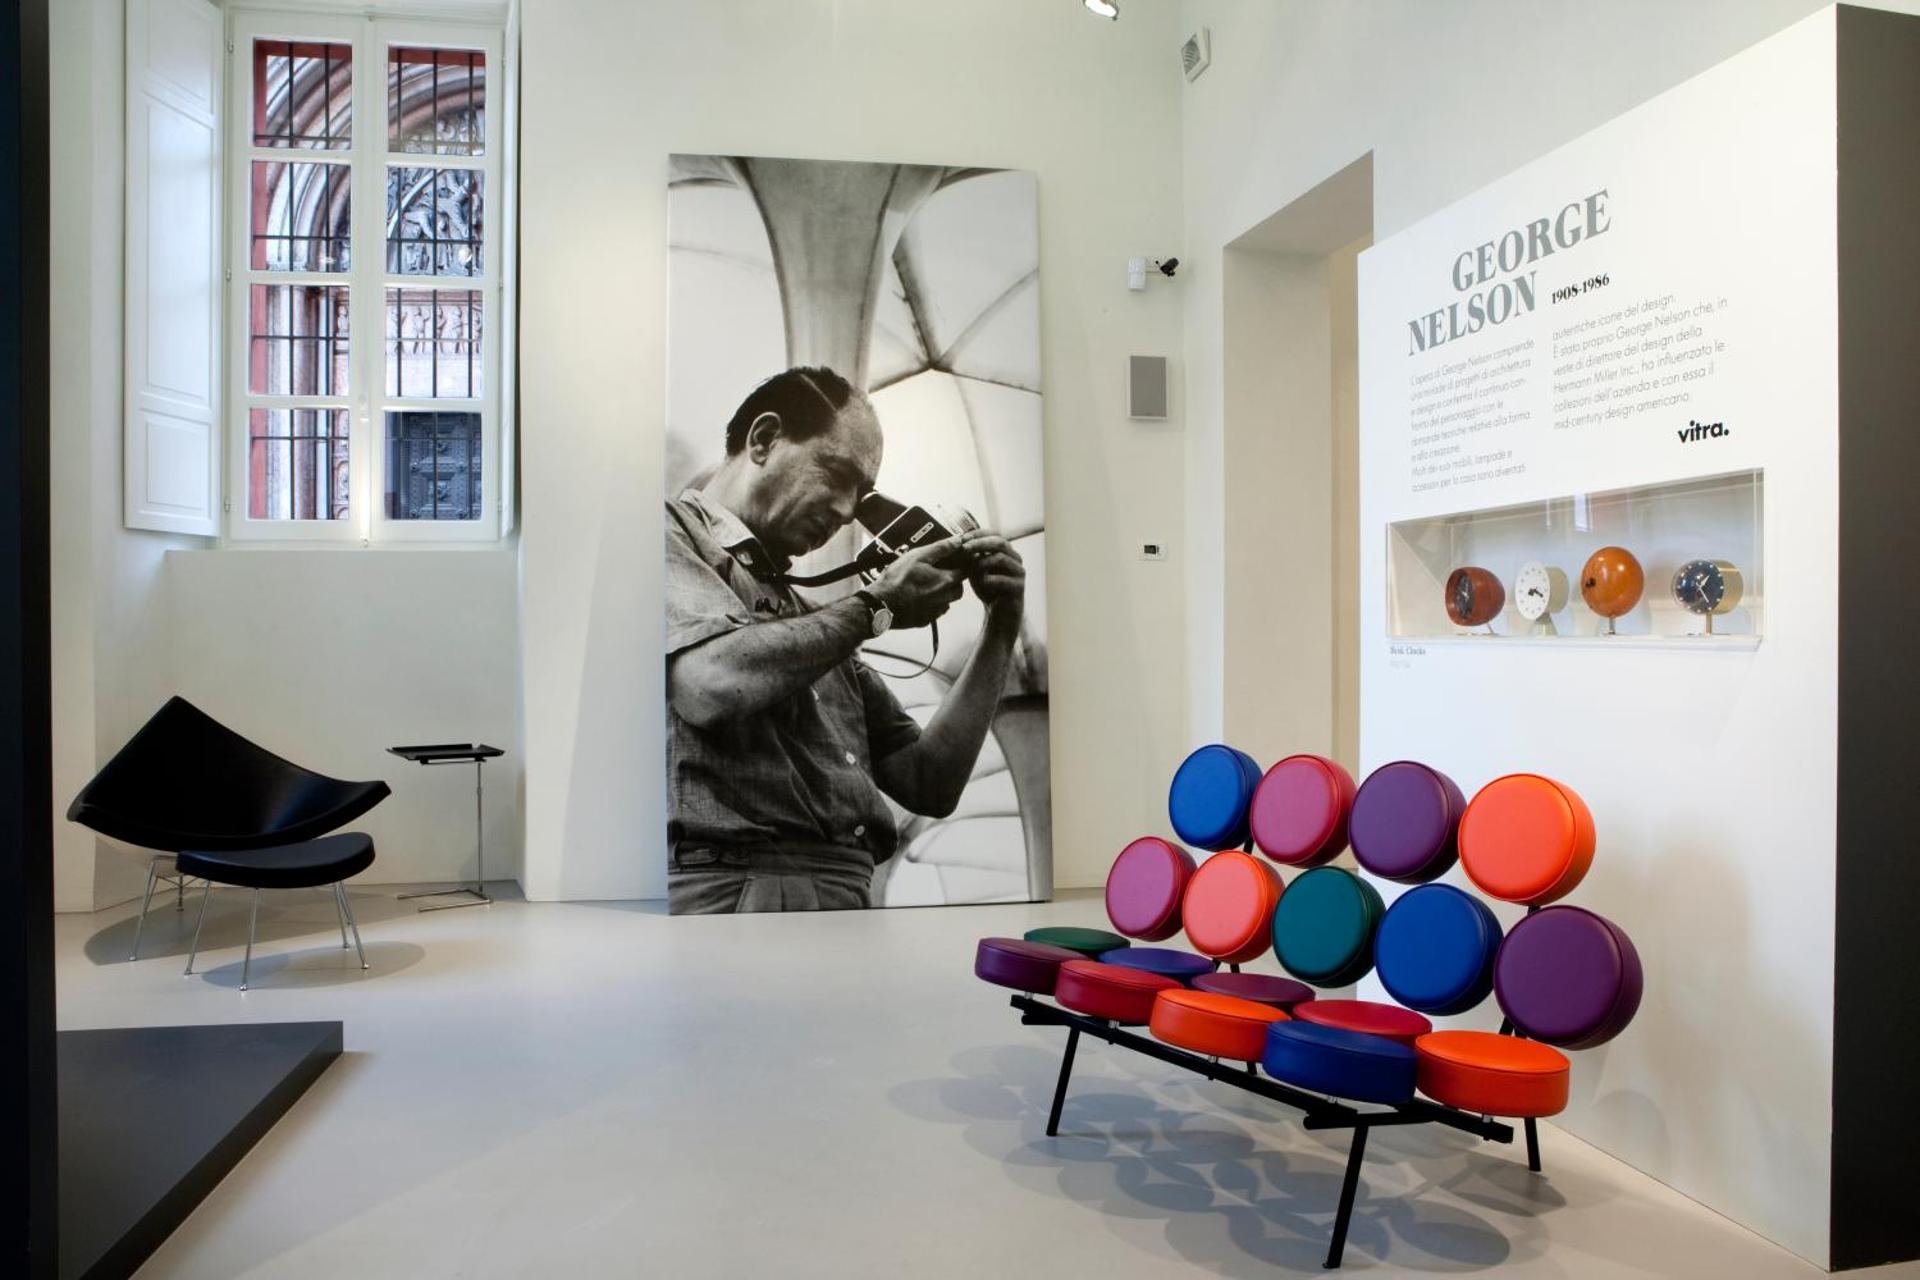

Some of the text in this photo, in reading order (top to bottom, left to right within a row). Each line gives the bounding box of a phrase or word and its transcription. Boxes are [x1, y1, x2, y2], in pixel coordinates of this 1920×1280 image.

[1452, 189, 1612, 292] GEORGE
[1550, 272, 1611, 305] 1908-1986
[1408, 270, 1538, 356] NELSON
[1615, 321, 1652, 340] George
[1654, 310, 1690, 329] Nelson
[1641, 335, 1673, 352] design
[1677, 420, 1730, 444] vitra.
